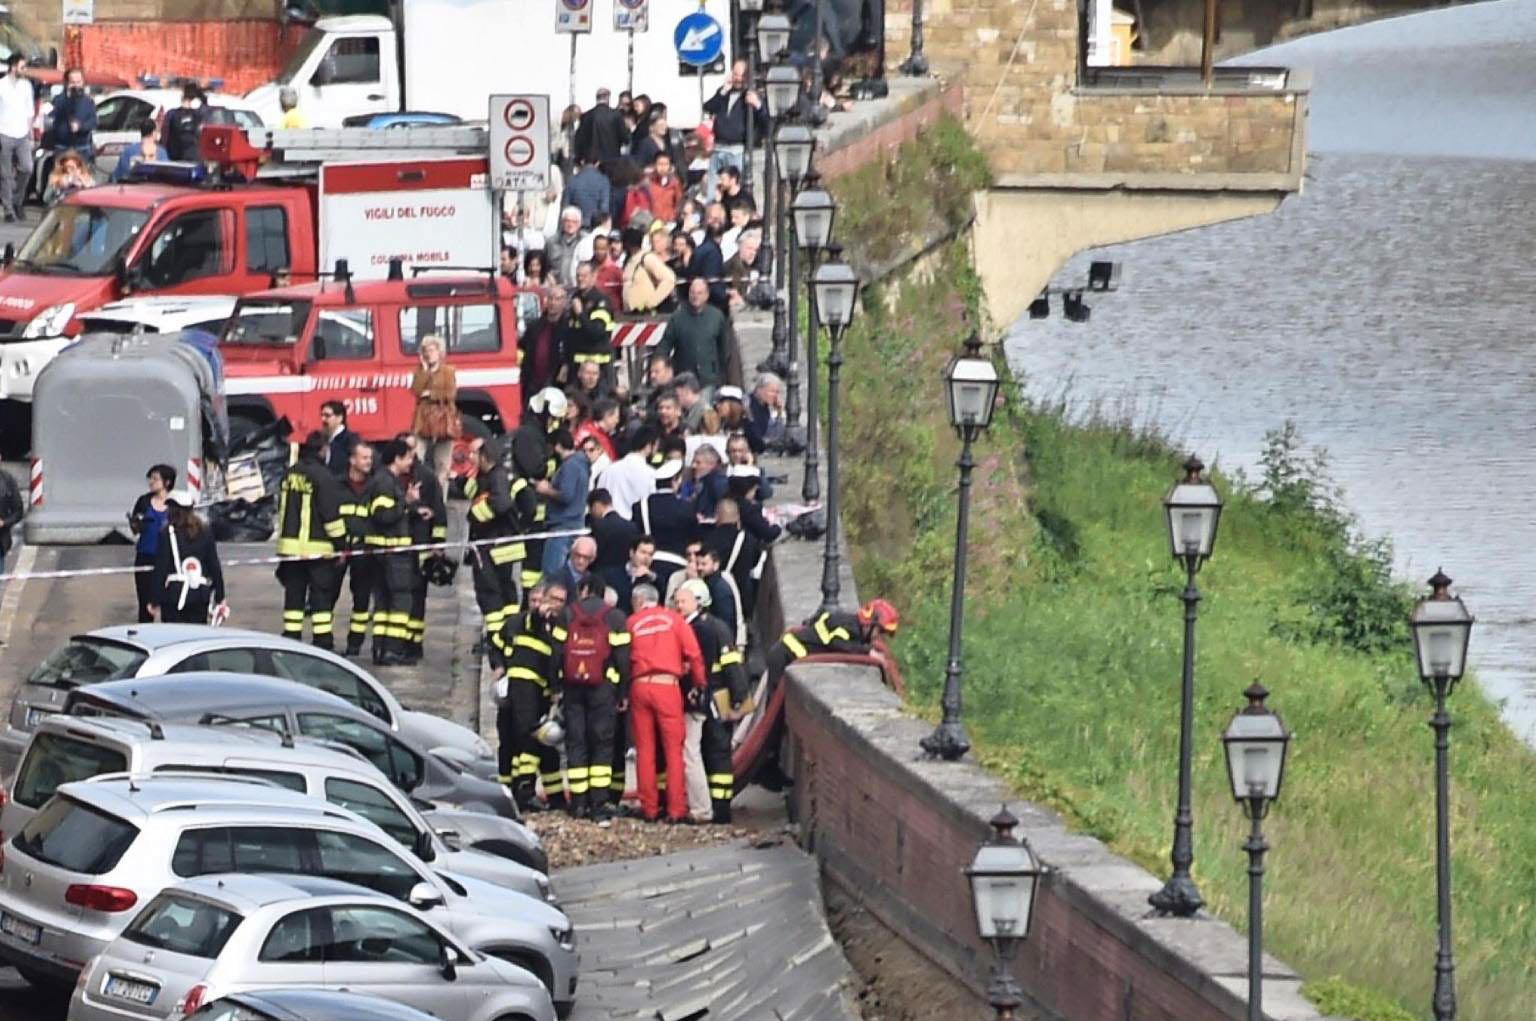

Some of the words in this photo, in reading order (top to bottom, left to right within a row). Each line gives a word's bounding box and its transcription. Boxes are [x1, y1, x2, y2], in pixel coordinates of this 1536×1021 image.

[364, 207, 394, 220] VIGILI
[397, 206, 416, 218] DEL
[419, 205, 457, 218] FUOCO
